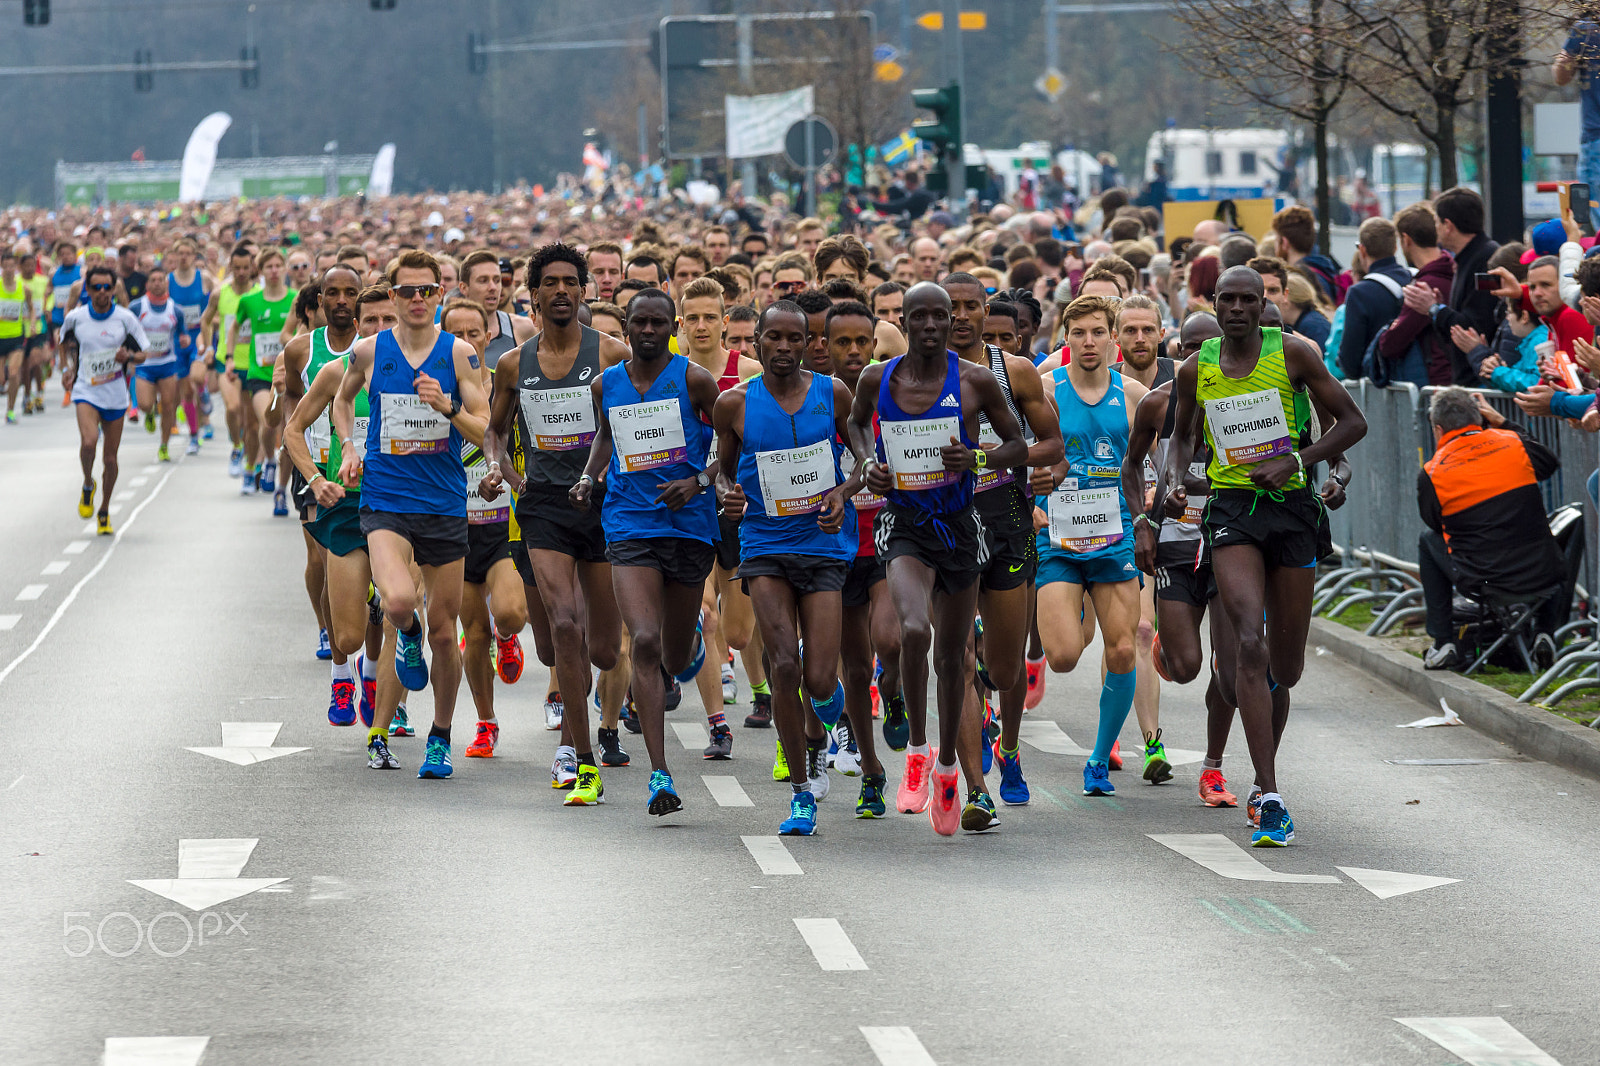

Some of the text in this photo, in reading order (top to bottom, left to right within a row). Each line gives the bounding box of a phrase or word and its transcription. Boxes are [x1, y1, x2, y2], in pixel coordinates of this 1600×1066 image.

[393, 397, 408, 407] SCC
[530, 392, 582, 402] SCC EVENTS
[1215, 395, 1270, 412] SCC EVENTS
[618, 405, 670, 418] SCC EVENTS
[404, 419, 438, 429] PHILIPP
[542, 412, 582, 424] TESFAYE
[891, 423, 949, 435] SCC EVENTS
[1222, 415, 1280, 436] KIPCHUMBA
[634, 427, 665, 441] CHEBII
[770, 447, 824, 463] SCC EVENTS
[903, 447, 943, 459] KAPTIC
[790, 471, 819, 486] KOGEI
[1060, 493, 1111, 503] SCC EVENTS
[1072, 514, 1109, 526] MARCEL
